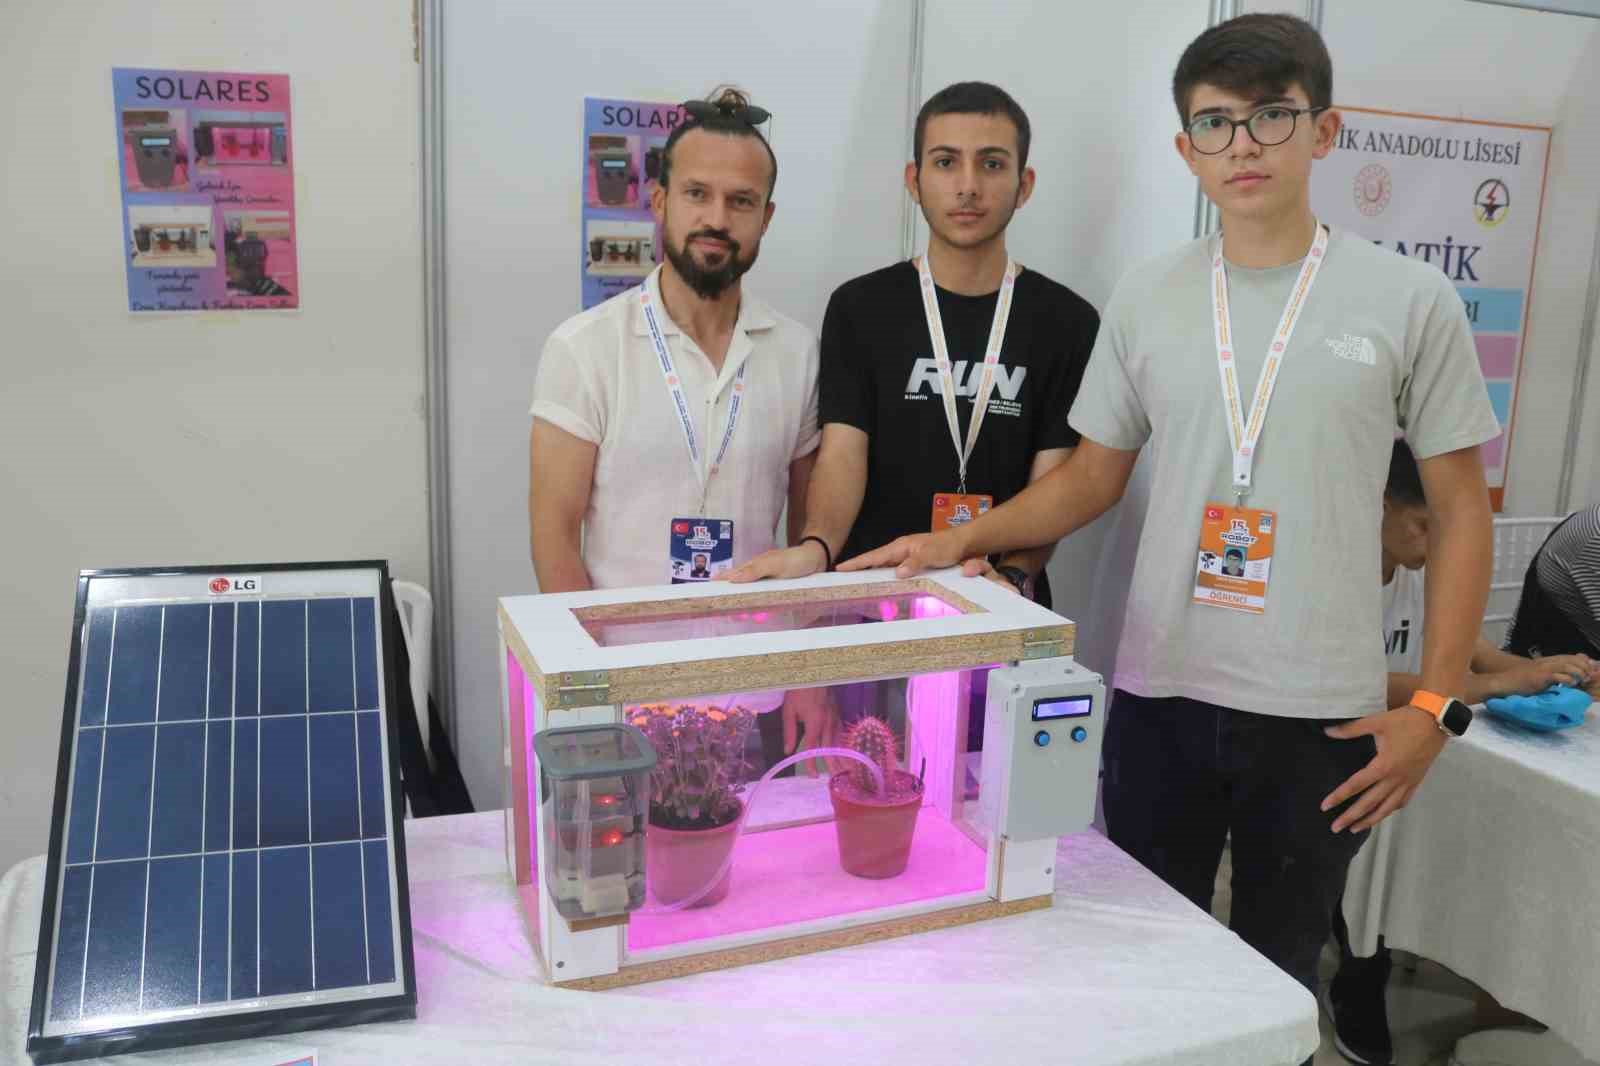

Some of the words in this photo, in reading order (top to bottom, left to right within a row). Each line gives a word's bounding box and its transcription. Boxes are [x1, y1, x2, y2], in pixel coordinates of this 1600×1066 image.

[136, 76, 270, 102] SOLARES
[602, 105, 680, 129] SOLAR
[1337, 124, 1361, 151] İK
[1363, 131, 1459, 160] ANADOLU
[1463, 137, 1521, 166] LİSESİ
[905, 357, 1027, 401] RUN
[234, 579, 257, 591] LG
